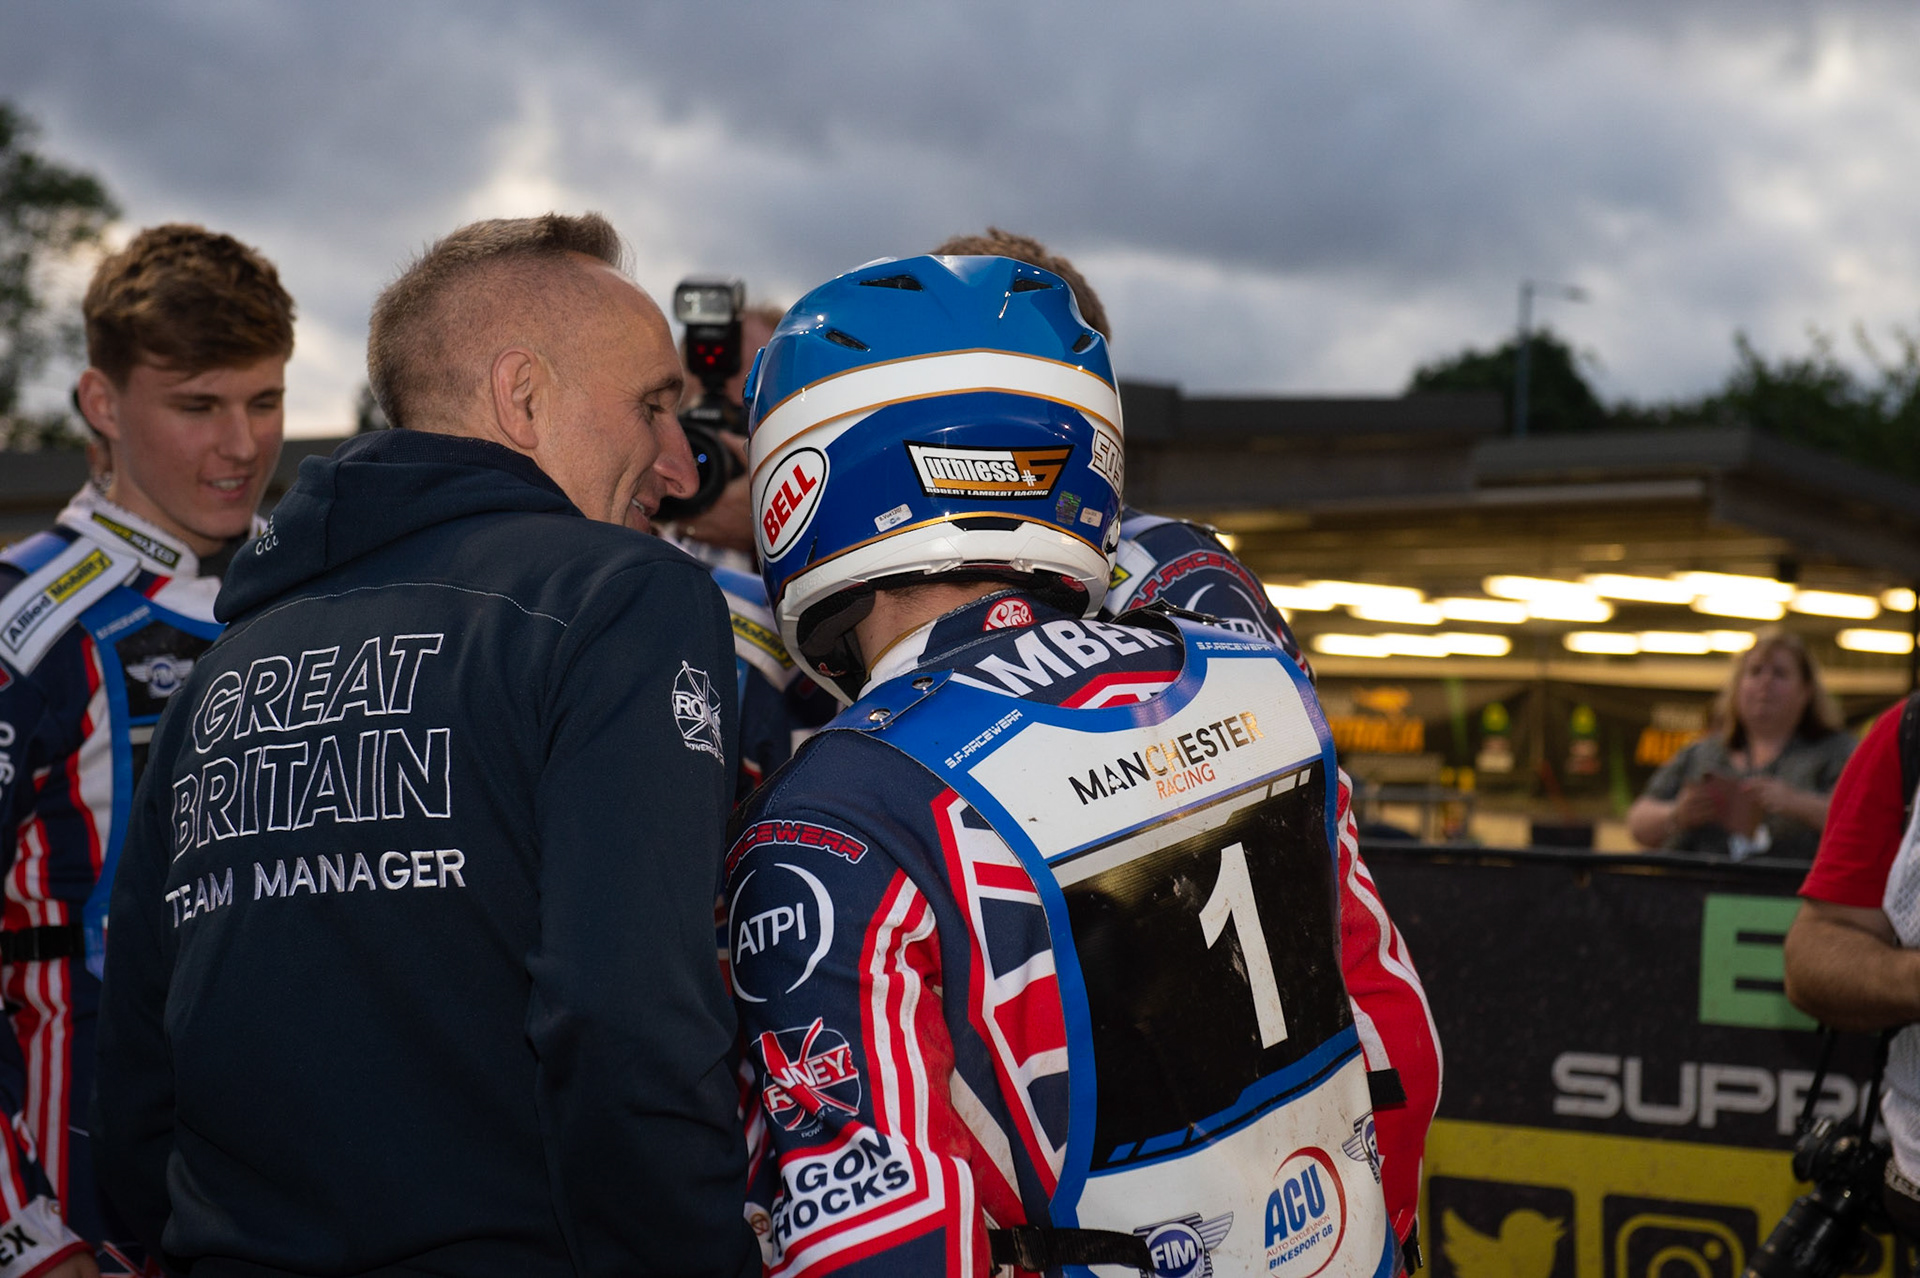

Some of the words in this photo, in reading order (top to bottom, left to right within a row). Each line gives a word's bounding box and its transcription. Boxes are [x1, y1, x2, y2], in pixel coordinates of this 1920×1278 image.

[763, 464, 817, 548] BELL
[926, 487, 965, 495] ROBERT
[967, 489, 1011, 497] LAMBERT
[9, 592, 53, 643] Allied
[193, 633, 445, 754] GREAT
[1068, 711, 1265, 806] MANCHESTER
[1155, 763, 1217, 801] RACING
[172, 728, 452, 864] BRITAIN
[165, 867, 233, 928] TEAM
[253, 848, 467, 900] MANAGER
[735, 902, 807, 965] ATPI
[1199, 842, 1288, 1049] 1
[1265, 1163, 1326, 1249] ACU
[1266, 1241, 1289, 1258] AUTO
[1289, 1227, 1312, 1245] CYCLE
[1310, 1214, 1331, 1232] UNION
[1150, 1239, 1197, 1270] FIM
[1269, 1231, 1321, 1271] BIKESPORT
[1321, 1223, 1334, 1238] GB
